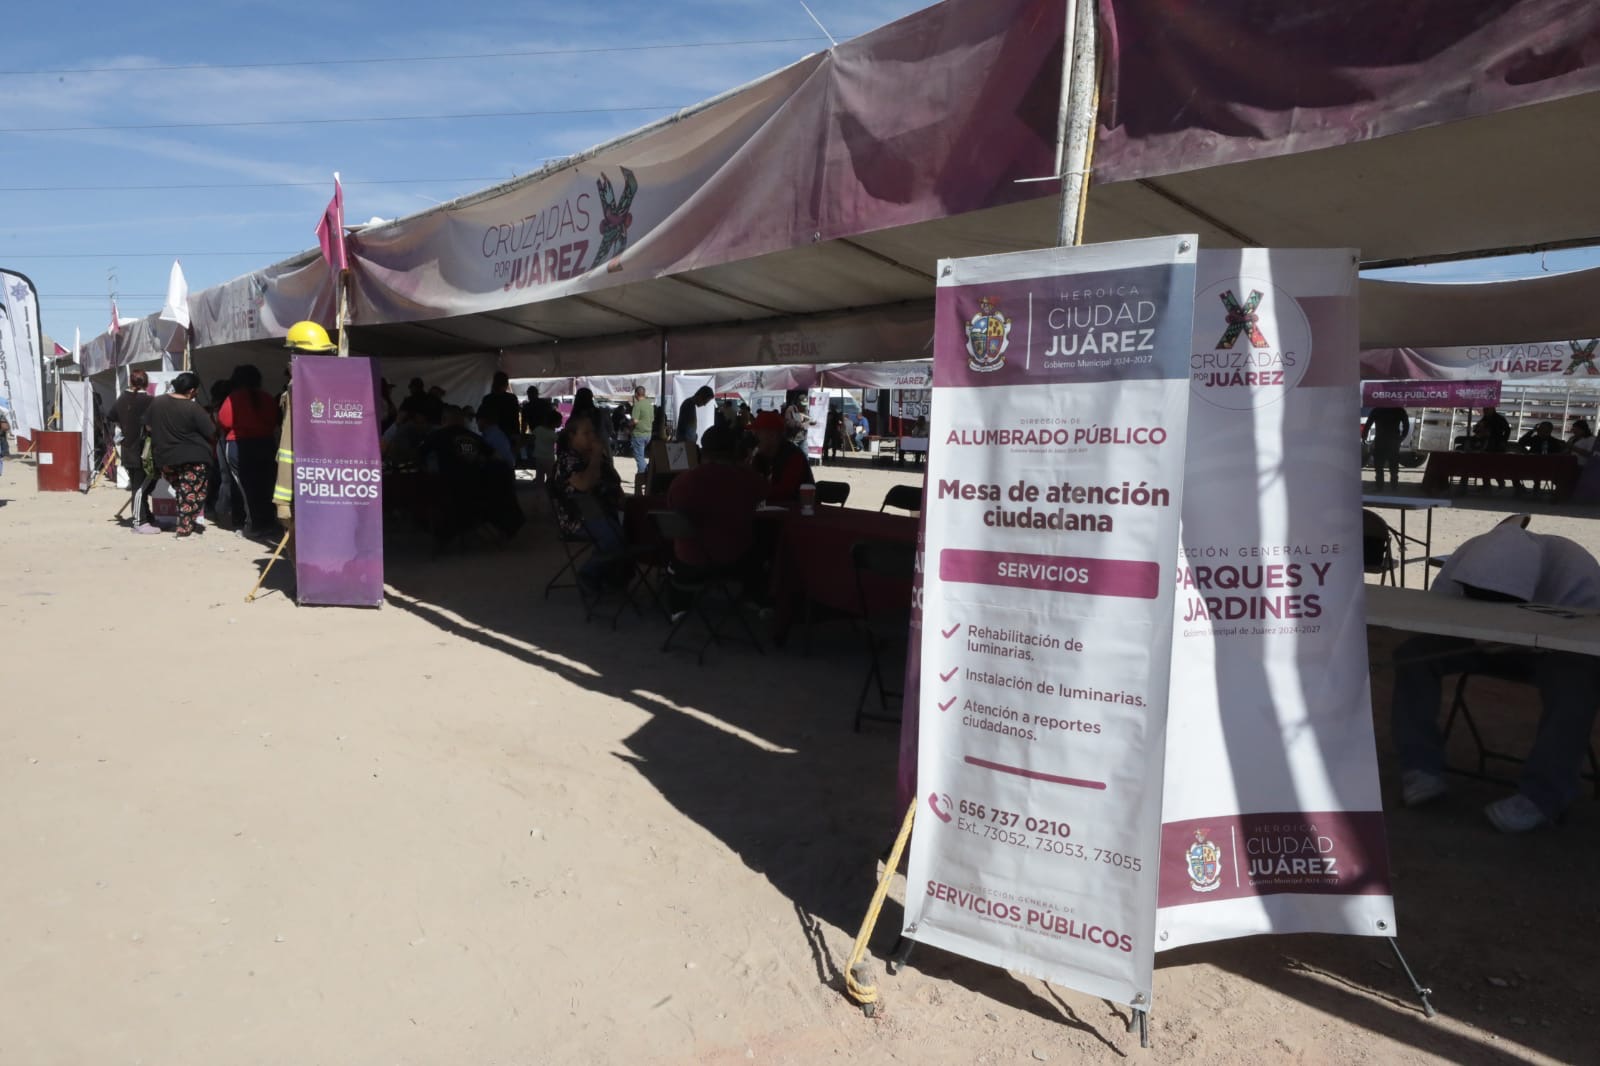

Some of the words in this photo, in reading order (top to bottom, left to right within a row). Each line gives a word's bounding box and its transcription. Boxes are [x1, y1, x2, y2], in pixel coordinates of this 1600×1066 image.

[482, 193, 590, 258] CRUZADAS
[494, 260, 510, 278] POR
[503, 240, 589, 292] JUÁREZ
[1060, 286, 1140, 301] HEROICA
[1048, 301, 1156, 330] CIUDAD
[1044, 328, 1156, 357] JUÁREZ
[1466, 343, 1565, 361] CRUZADAS
[1044, 360, 1076, 369] Gobierno
[1077, 358, 1112, 368] Municipal
[1191, 351, 1297, 370] CRUZADAS
[1488, 357, 1563, 374] JUÁREZ
[1193, 373, 1209, 381] POR
[1205, 368, 1285, 388] JUÁREZ
[1371, 390, 1403, 399] OBRAS
[1020, 416, 1067, 425] DIRECCIÓN
[1070, 417, 1081, 425] DE
[945, 428, 1069, 446] ALUMBRADO
[1074, 424, 1168, 445] PÚBLICO
[296, 466, 381, 482] SERVICIOS
[299, 480, 379, 499] PÚBLICOS
[937, 479, 1002, 502] Mesa
[1008, 480, 1040, 503] de
[1046, 481, 1171, 507] atención
[983, 506, 1114, 533] ciudadana
[1178, 545, 1229, 558] ECCIÓN
[1238, 544, 1313, 558] GENERAL
[1320, 543, 1341, 555] DE
[997, 561, 1090, 584] SERVICIOS
[1309, 562, 1332, 587] Y
[1183, 594, 1323, 622] JARDINES
[967, 624, 1060, 650] Rehabilitación
[1064, 638, 1084, 653] de
[1239, 626, 1249, 635] de
[967, 639, 1035, 662] luminarias.
[965, 668, 1033, 692] Instalación
[1036, 681, 1055, 695] de
[1059, 683, 1148, 708] luminarias.
[962, 714, 1038, 741] ciudadanos.
[963, 698, 1019, 721] Atención
[1022, 713, 1030, 724] a
[1034, 715, 1102, 735] reportes
[959, 799, 986, 820] 656
[990, 808, 1020, 828] 737
[1025, 816, 1071, 839] 0210
[1255, 824, 1318, 833] HEROICA
[957, 817, 980, 836] Ext.
[1093, 848, 1143, 873] 73055
[1246, 836, 1334, 855] CIUDAD
[1247, 854, 1339, 877] JUÁREZ
[926, 879, 1022, 923] SERVICIOS
[1027, 910, 1133, 953] PÚBLICOS
